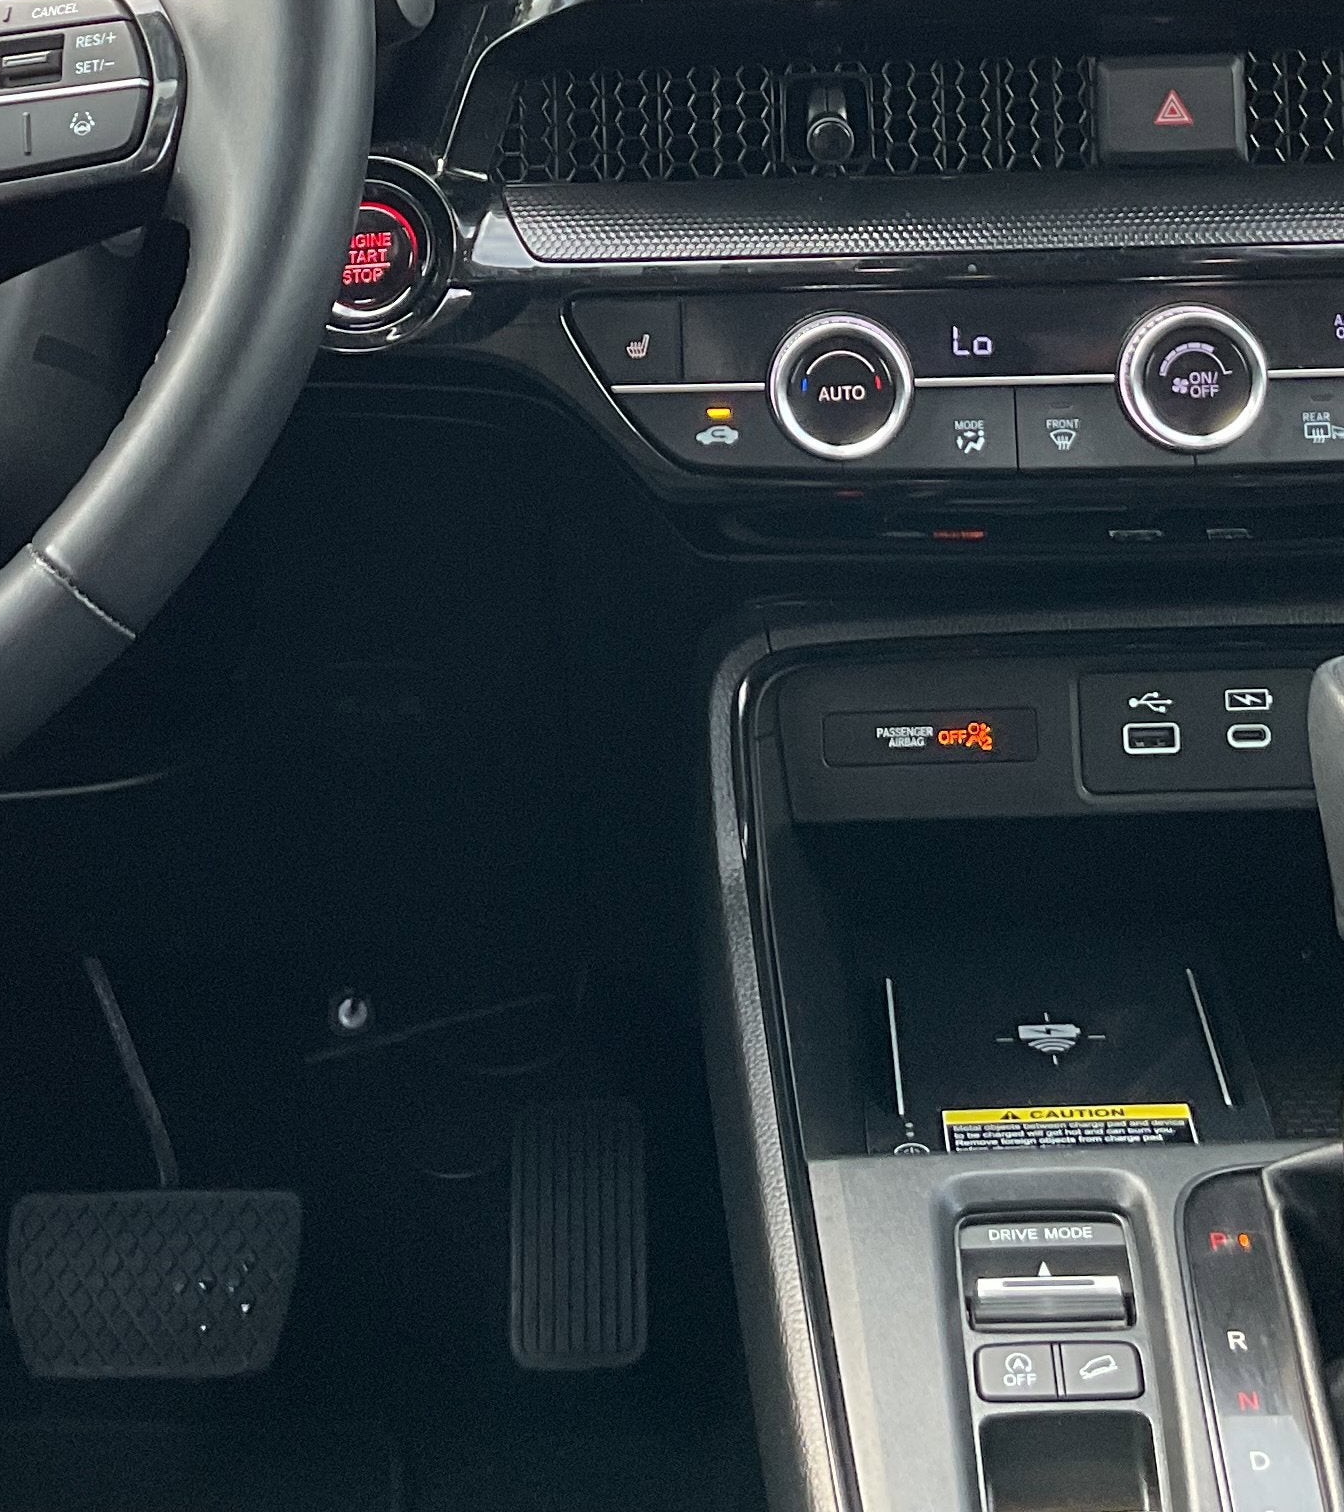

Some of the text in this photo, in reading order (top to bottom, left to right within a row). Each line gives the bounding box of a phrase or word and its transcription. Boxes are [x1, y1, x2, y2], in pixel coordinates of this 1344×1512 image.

[31, 2, 80, 19] CANCEL
[350, 232, 392, 248] GINE
[348, 248, 388, 264] TART
[342, 268, 384, 285] STOP
[952, 326, 993, 356] Lo
[1189, 371, 1218, 385] ON/
[818, 385, 866, 403] AUTO
[1189, 384, 1219, 398] OFF
[954, 420, 984, 430] MODE
[1046, 419, 1080, 430] FRONT
[1302, 411, 1331, 423] REAR
[876, 725, 934, 740] PASSENGER
[937, 729, 967, 746] OFF
[888, 736, 925, 748] AIRBAG
[1029, 1108, 1126, 1119] CAUTION
[988, 1225, 1093, 1242] DRIVE MODE
[1208, 1231, 1227, 1251] P
[1227, 1330, 1248, 1351] R
[1003, 1374, 1037, 1387] OFF
[1238, 1391, 1260, 1411] N
[1249, 1451, 1270, 1471] D
